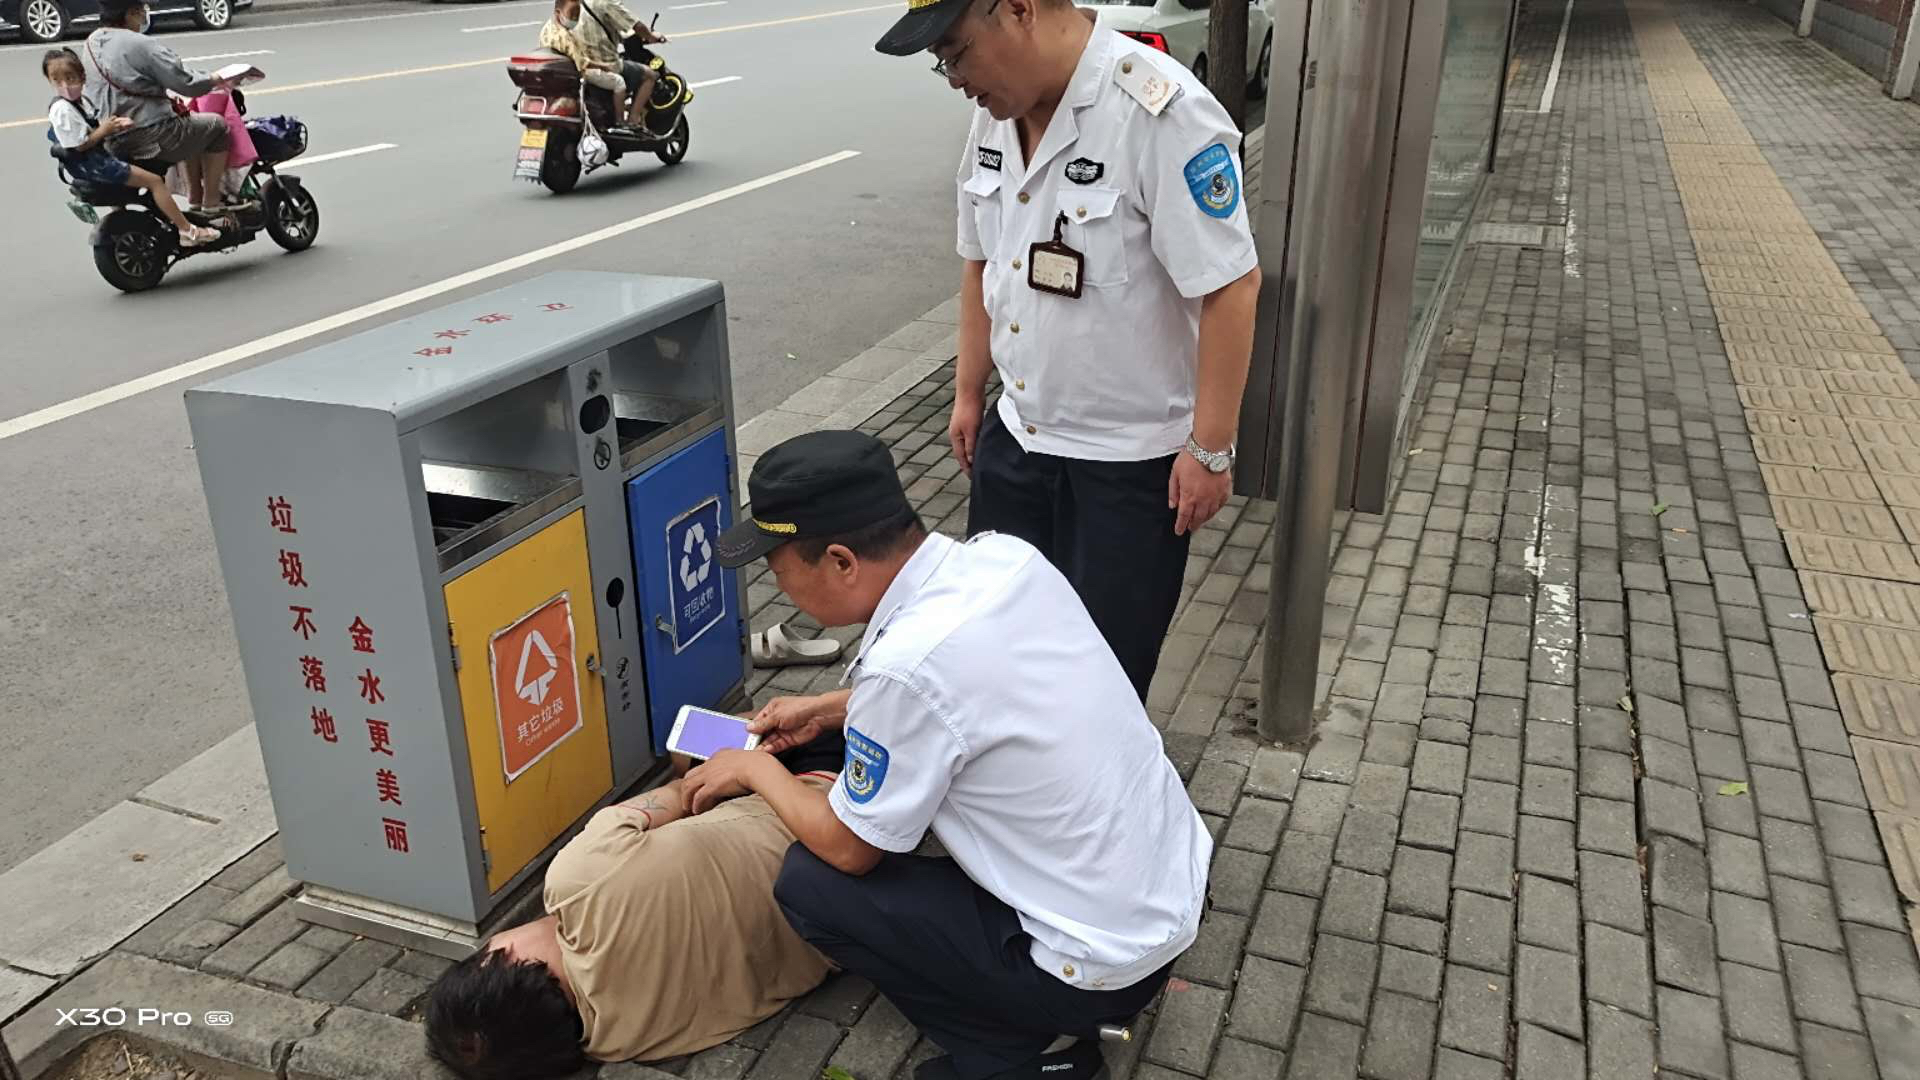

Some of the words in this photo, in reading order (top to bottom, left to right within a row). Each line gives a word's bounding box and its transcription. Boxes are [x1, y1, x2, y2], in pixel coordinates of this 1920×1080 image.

[267, 495, 338, 744] 垃圾不落地
[348, 615, 409, 853] 金水更美丽
[517, 696, 565, 743] 其它垃圾
